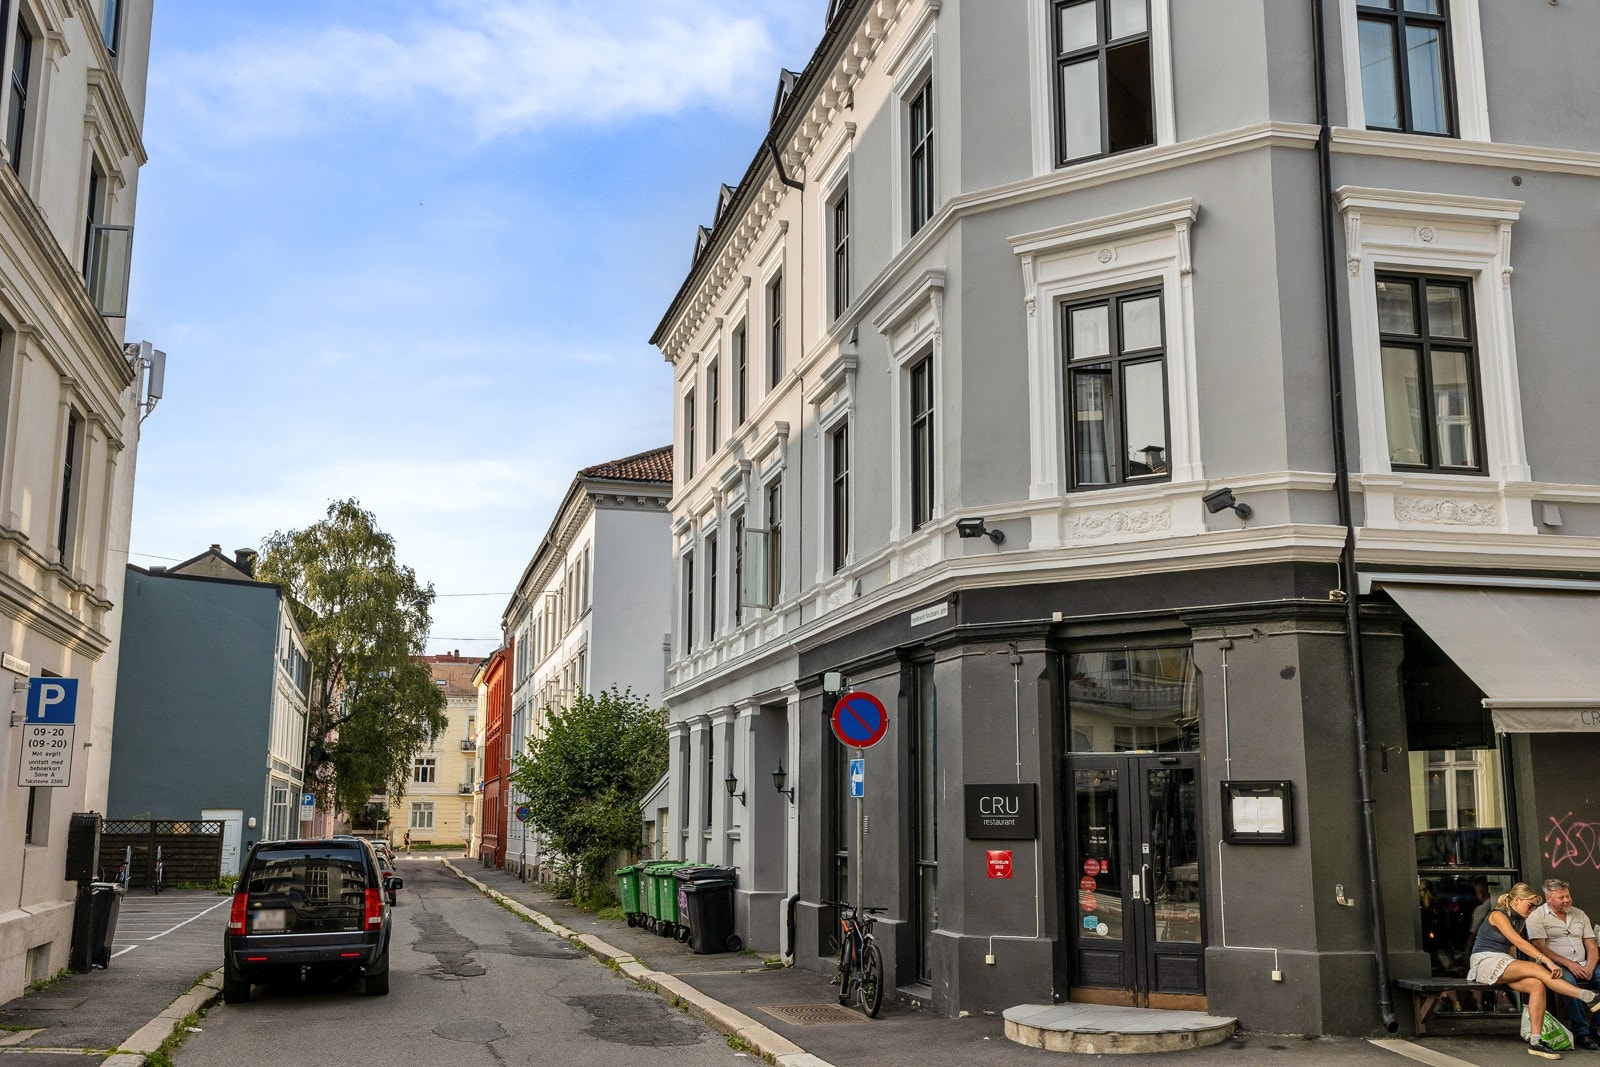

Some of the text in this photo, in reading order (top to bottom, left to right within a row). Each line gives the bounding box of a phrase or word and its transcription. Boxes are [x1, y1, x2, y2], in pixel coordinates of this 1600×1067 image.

[38, 683, 66, 718] P
[304, 795, 312, 805] P
[980, 796, 1019, 814] CRU
[983, 818, 1016, 826] restaurant
